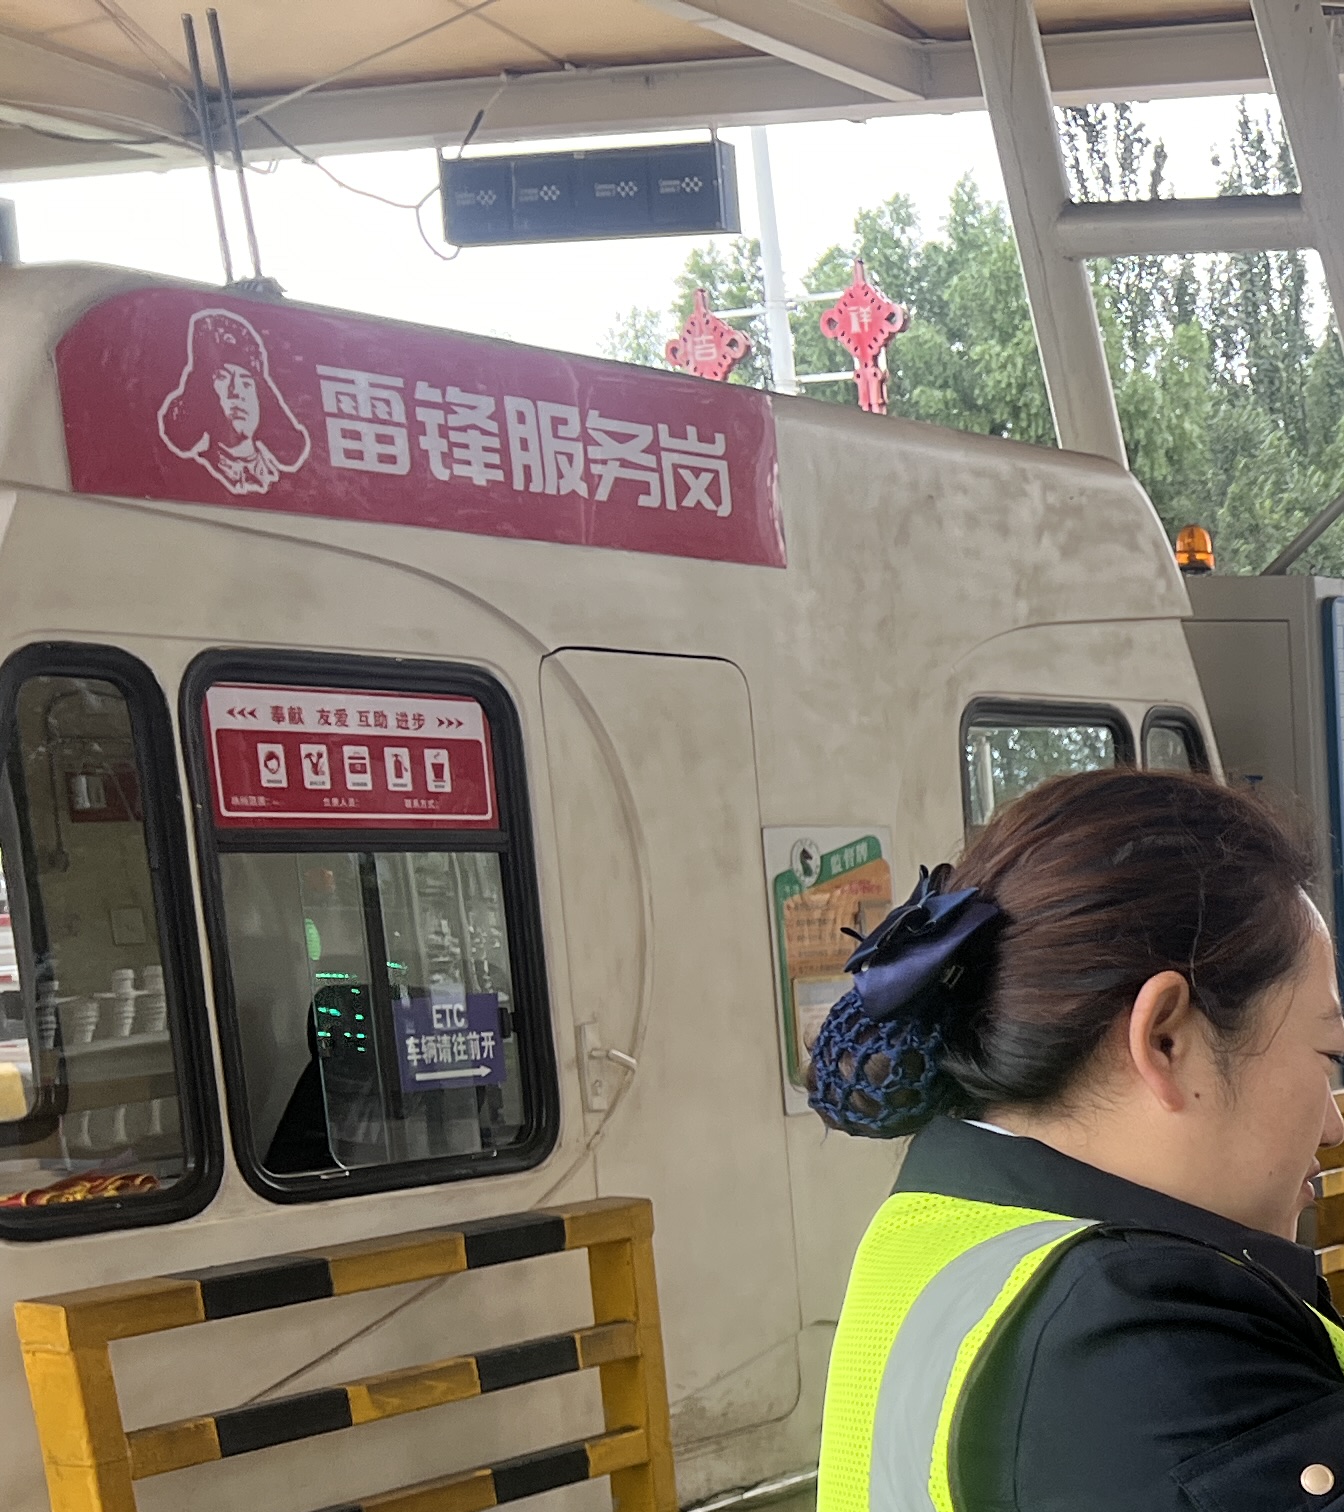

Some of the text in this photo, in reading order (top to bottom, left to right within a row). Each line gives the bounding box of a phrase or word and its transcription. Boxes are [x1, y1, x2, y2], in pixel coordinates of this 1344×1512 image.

[316, 364, 733, 517] 雷锋服务岗
[270, 705, 426, 731] 奉献 友爱 互助 进步
[432, 1003, 465, 1028] ETC
[406, 1031, 496, 1066] 车辆请往前开
